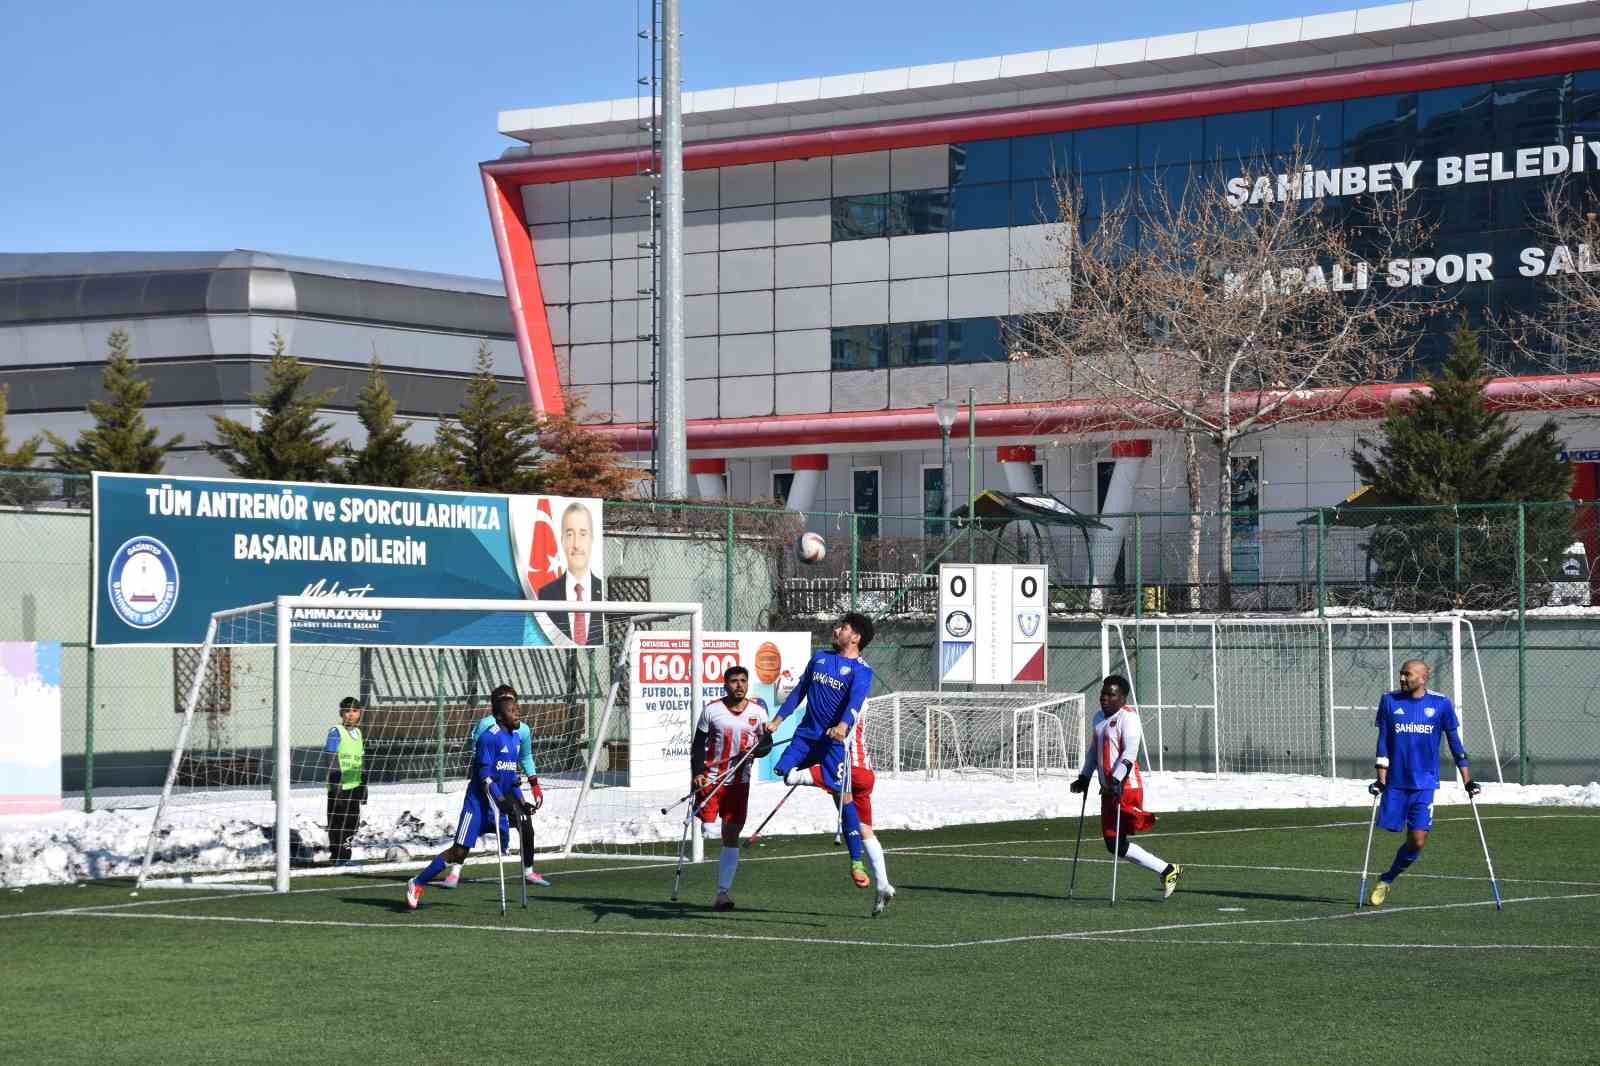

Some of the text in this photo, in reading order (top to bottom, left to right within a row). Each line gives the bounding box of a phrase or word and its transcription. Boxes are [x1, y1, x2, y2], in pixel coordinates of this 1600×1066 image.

[1226, 160, 1423, 211] ŞAHİNBEY
[1386, 252, 1494, 288] SPOR
[146, 484, 501, 531] TÜM ANTRENÖR ve SPORCULARIMIZA
[234, 533, 427, 566] BAŞARILAR DİLERİM
[950, 575, 967, 597] 0
[1021, 576, 1038, 598] 0
[642, 687, 682, 699] FUTBOL,
[646, 702, 657, 711] ve
[1394, 721, 1434, 734] ŞAHİNBEY
